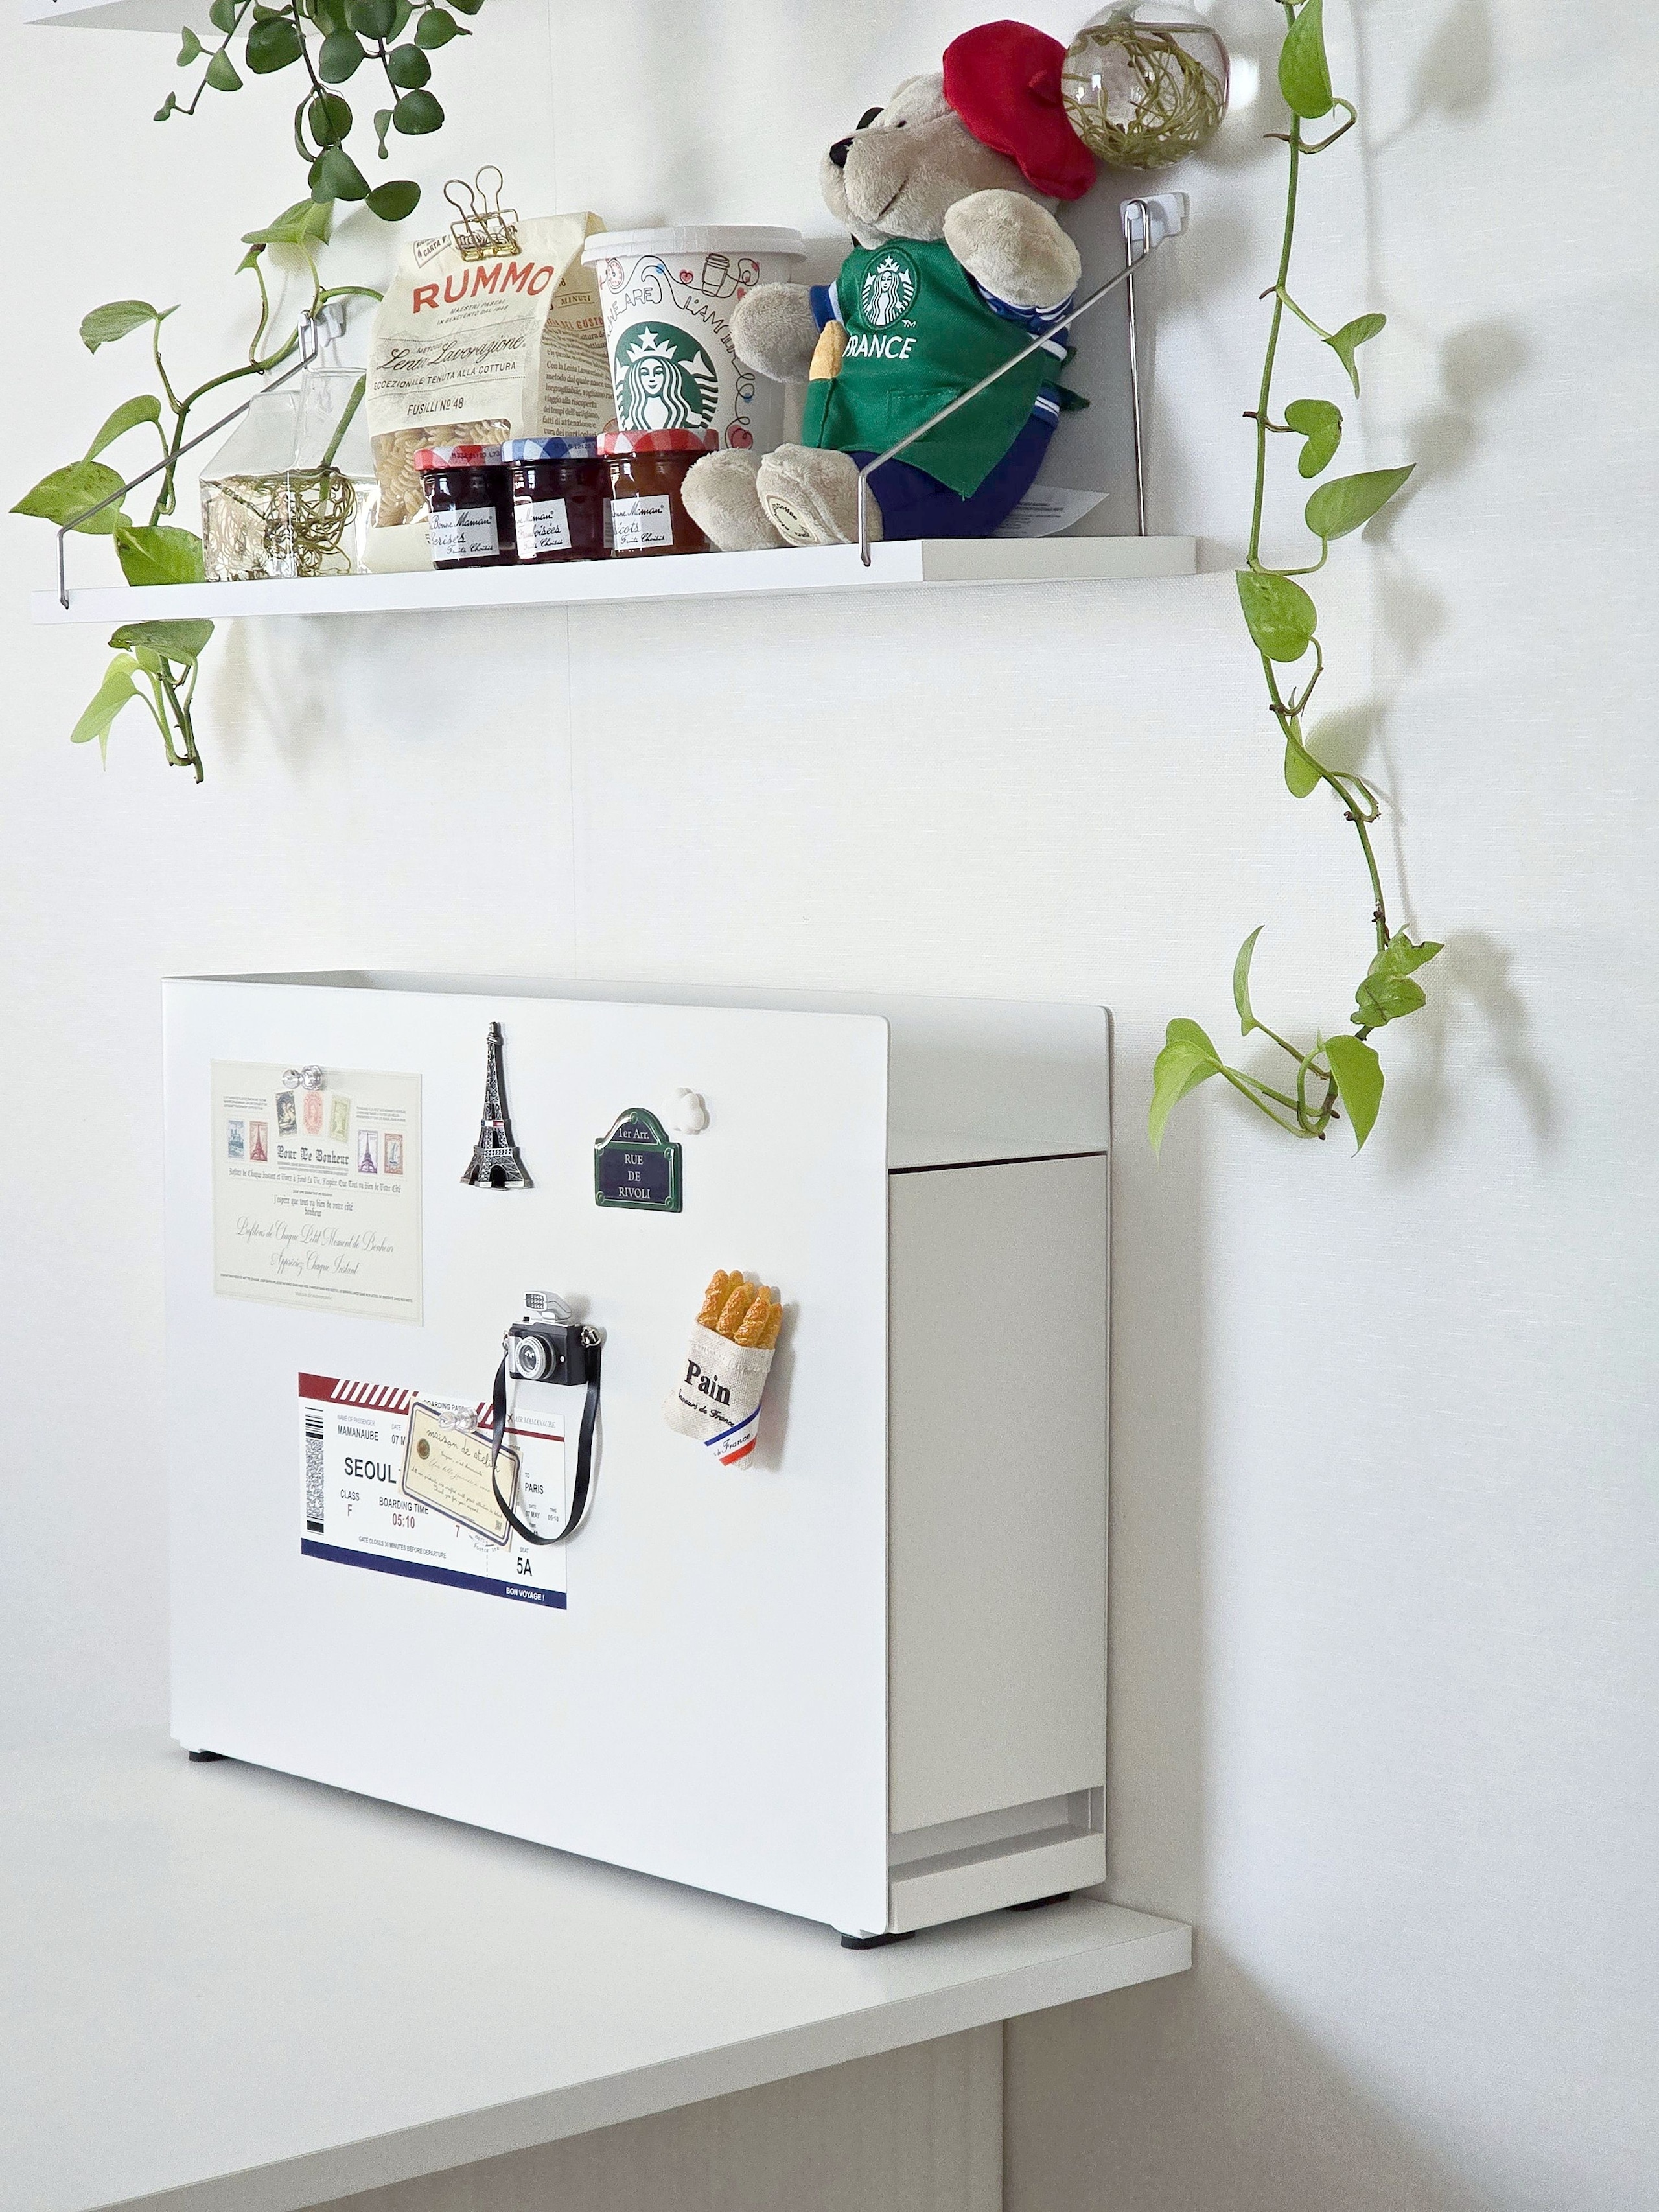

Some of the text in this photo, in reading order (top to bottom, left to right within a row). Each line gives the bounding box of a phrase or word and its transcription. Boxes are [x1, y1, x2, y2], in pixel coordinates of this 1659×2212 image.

[423, 240, 441, 257] CARTA
[413, 261, 555, 314] RUMMO
[561, 295, 591, 305] MINUTI
[576, 316, 604, 329] GUSTO
[427, 334, 524, 366] Lavorazione
[427, 371, 455, 385] TENUTA
[457, 366, 477, 378] ALLA
[478, 361, 516, 375] COTTURA
[407, 401, 438, 417] FUSILLI
[453, 397, 465, 410] 48
[454, 511, 491, 527] Maman
[618, 1128, 650, 1139] 1er Arr.
[316, 1148, 350, 1165] Bonheur
[624, 1154, 644, 1165] RUE
[627, 1170, 642, 1182] DE
[618, 1186, 651, 1199] RIVOLI
[684, 1359, 731, 1406] Pain
[338, 1425, 378, 1441] MAMANAUBE
[391, 1434, 399, 1445] 07
[721, 1433, 751, 1454] France
[461, 1438, 471, 1456] de
[474, 1449, 501, 1473] atelir
[344, 1457, 397, 1484] SEOUL
[340, 1489, 360, 1501] CLASS
[525, 1482, 544, 1495] PARIS
[347, 1504, 353, 1517] F
[379, 1496, 429, 1515] BOARDING TIME
[392, 1513, 415, 1529] 05:10
[456, 1524, 460, 1538] 7
[369, 1538, 384, 1546] CLOSES
[389, 1542, 406, 1551] MINUTES
[406, 1545, 423, 1554] BEFORE
[423, 1548, 447, 1559] DEPARTURE
[516, 1557, 533, 1577] 5A
[505, 1587, 518, 1596] BON
[519, 1589, 542, 1601] VOYAGE
